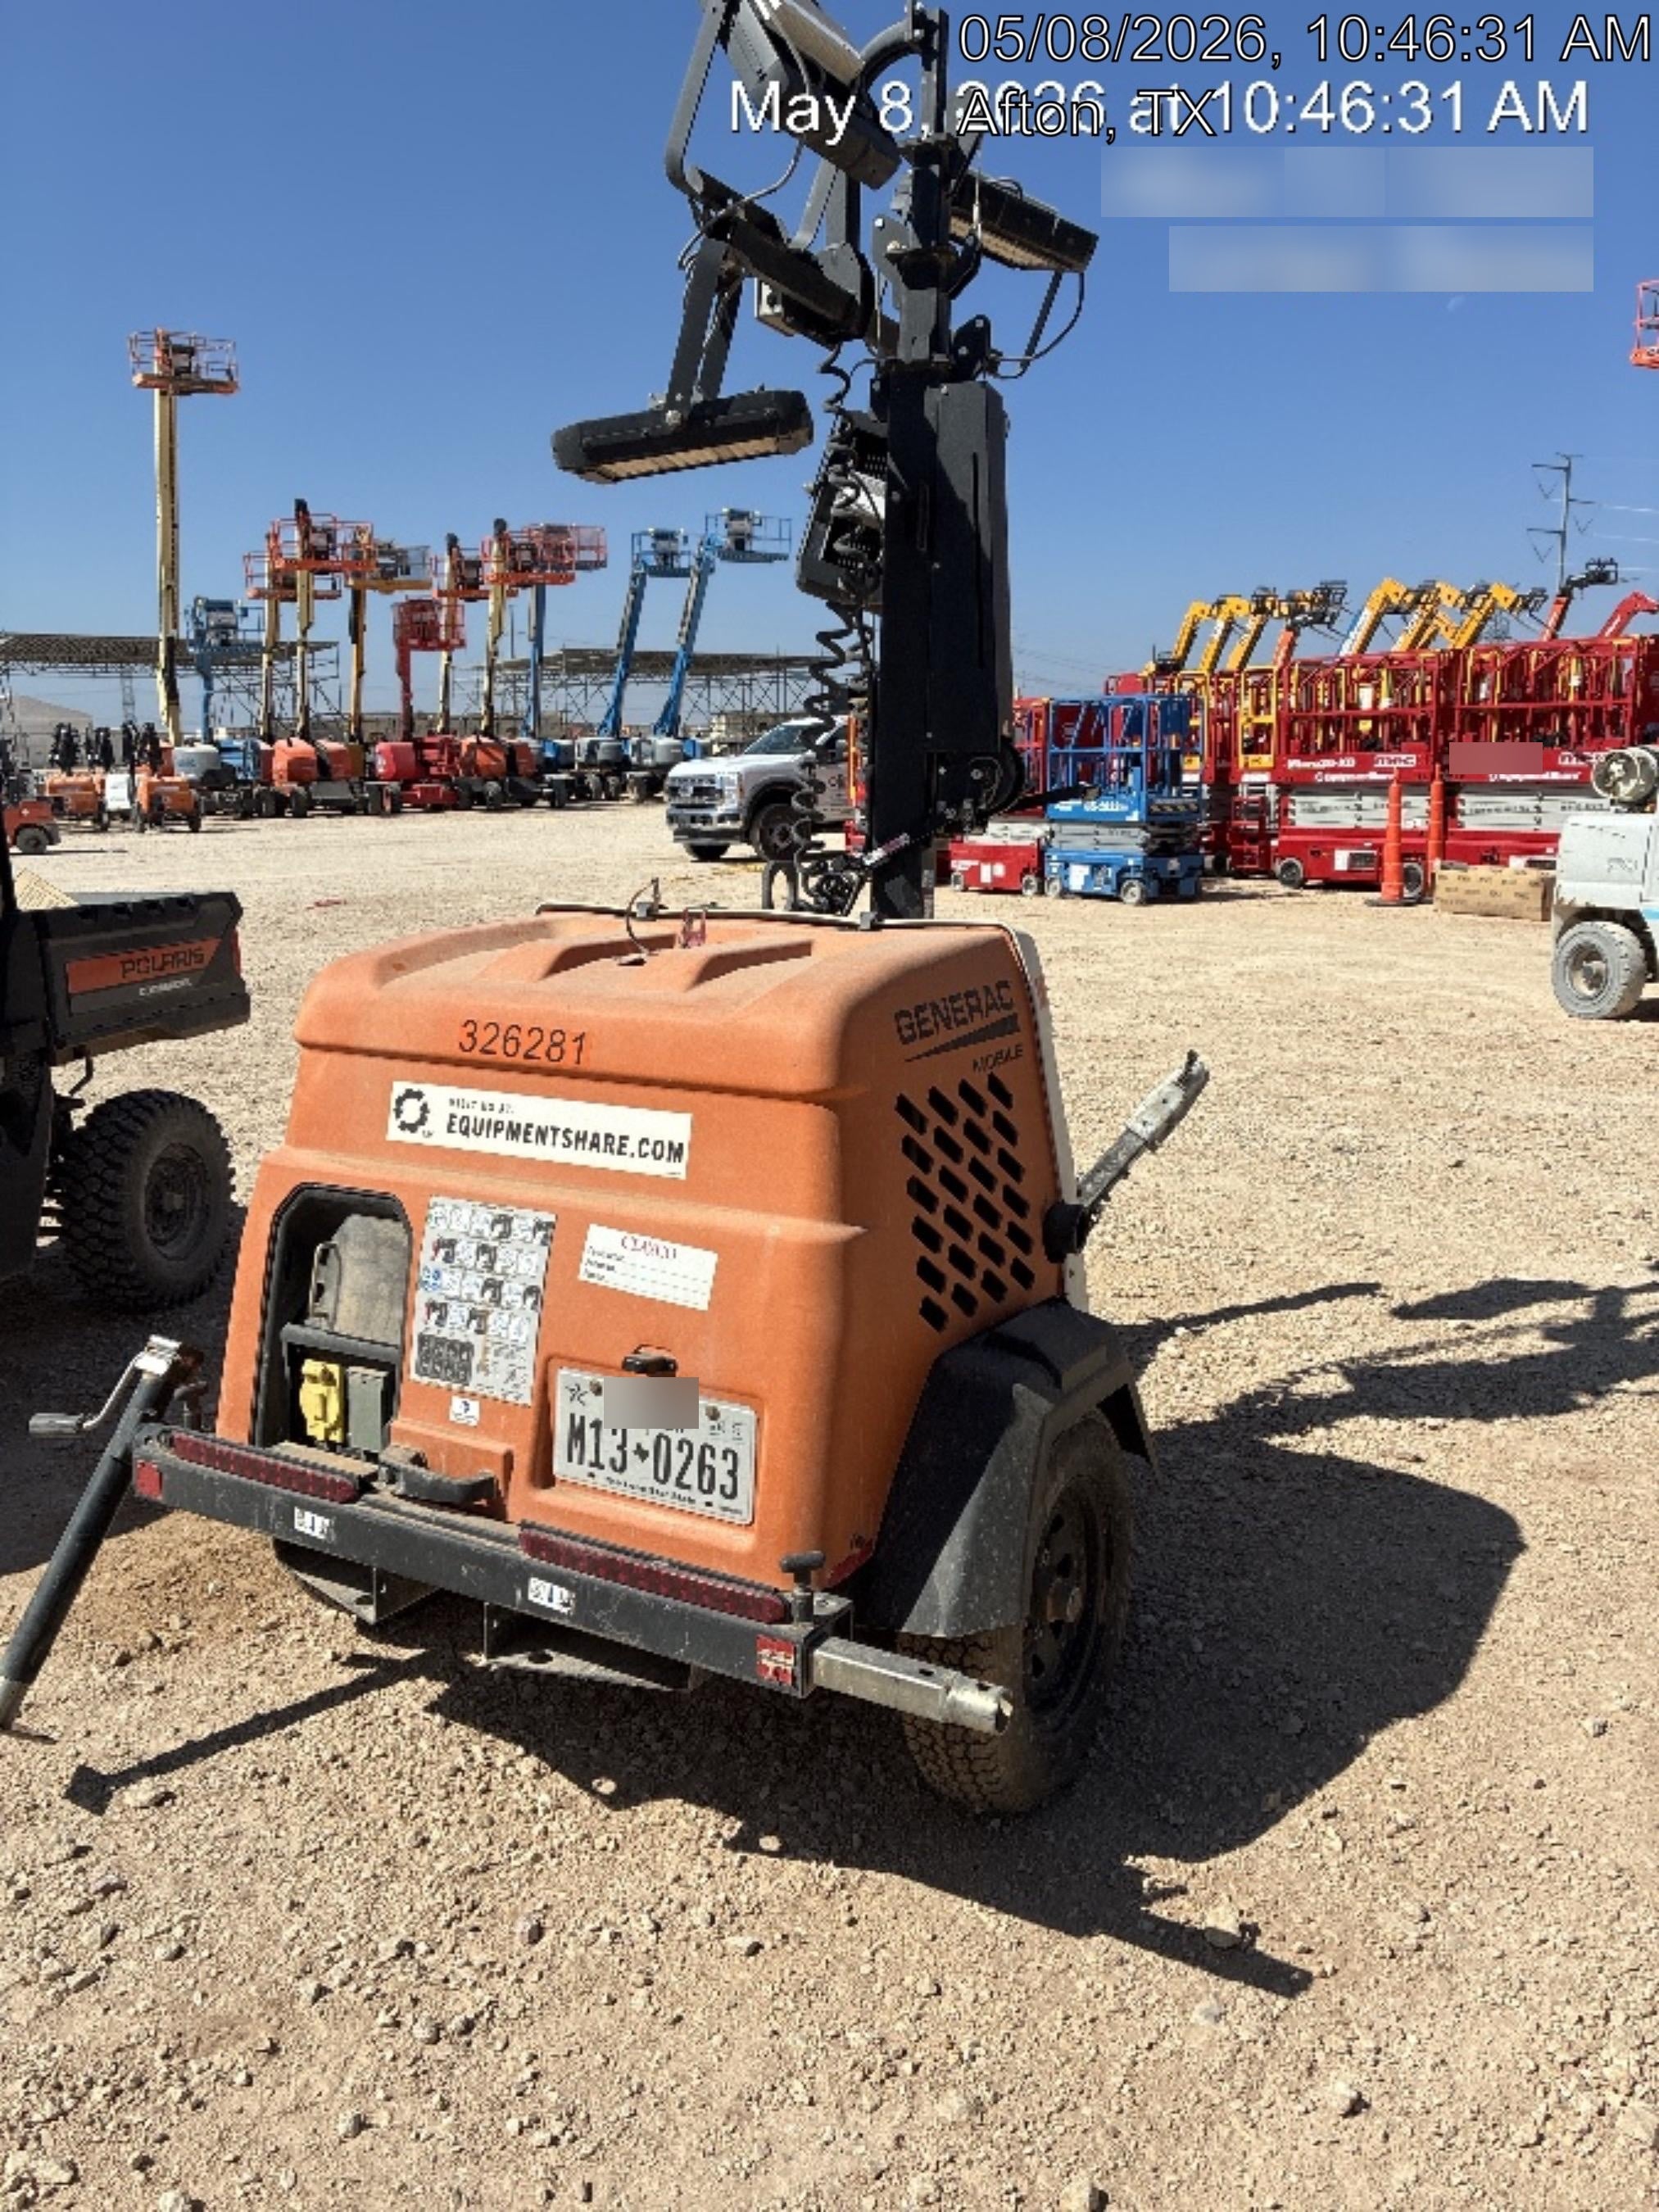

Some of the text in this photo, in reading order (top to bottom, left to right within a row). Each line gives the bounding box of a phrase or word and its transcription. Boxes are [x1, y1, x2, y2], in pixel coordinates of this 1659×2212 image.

[120, 945, 204, 978] POLARIS
[894, 981, 1013, 1045] GENERAC
[458, 1018, 587, 1065] 326281
[446, 1113, 685, 1163] EQUIPMENTSHARE.COM
